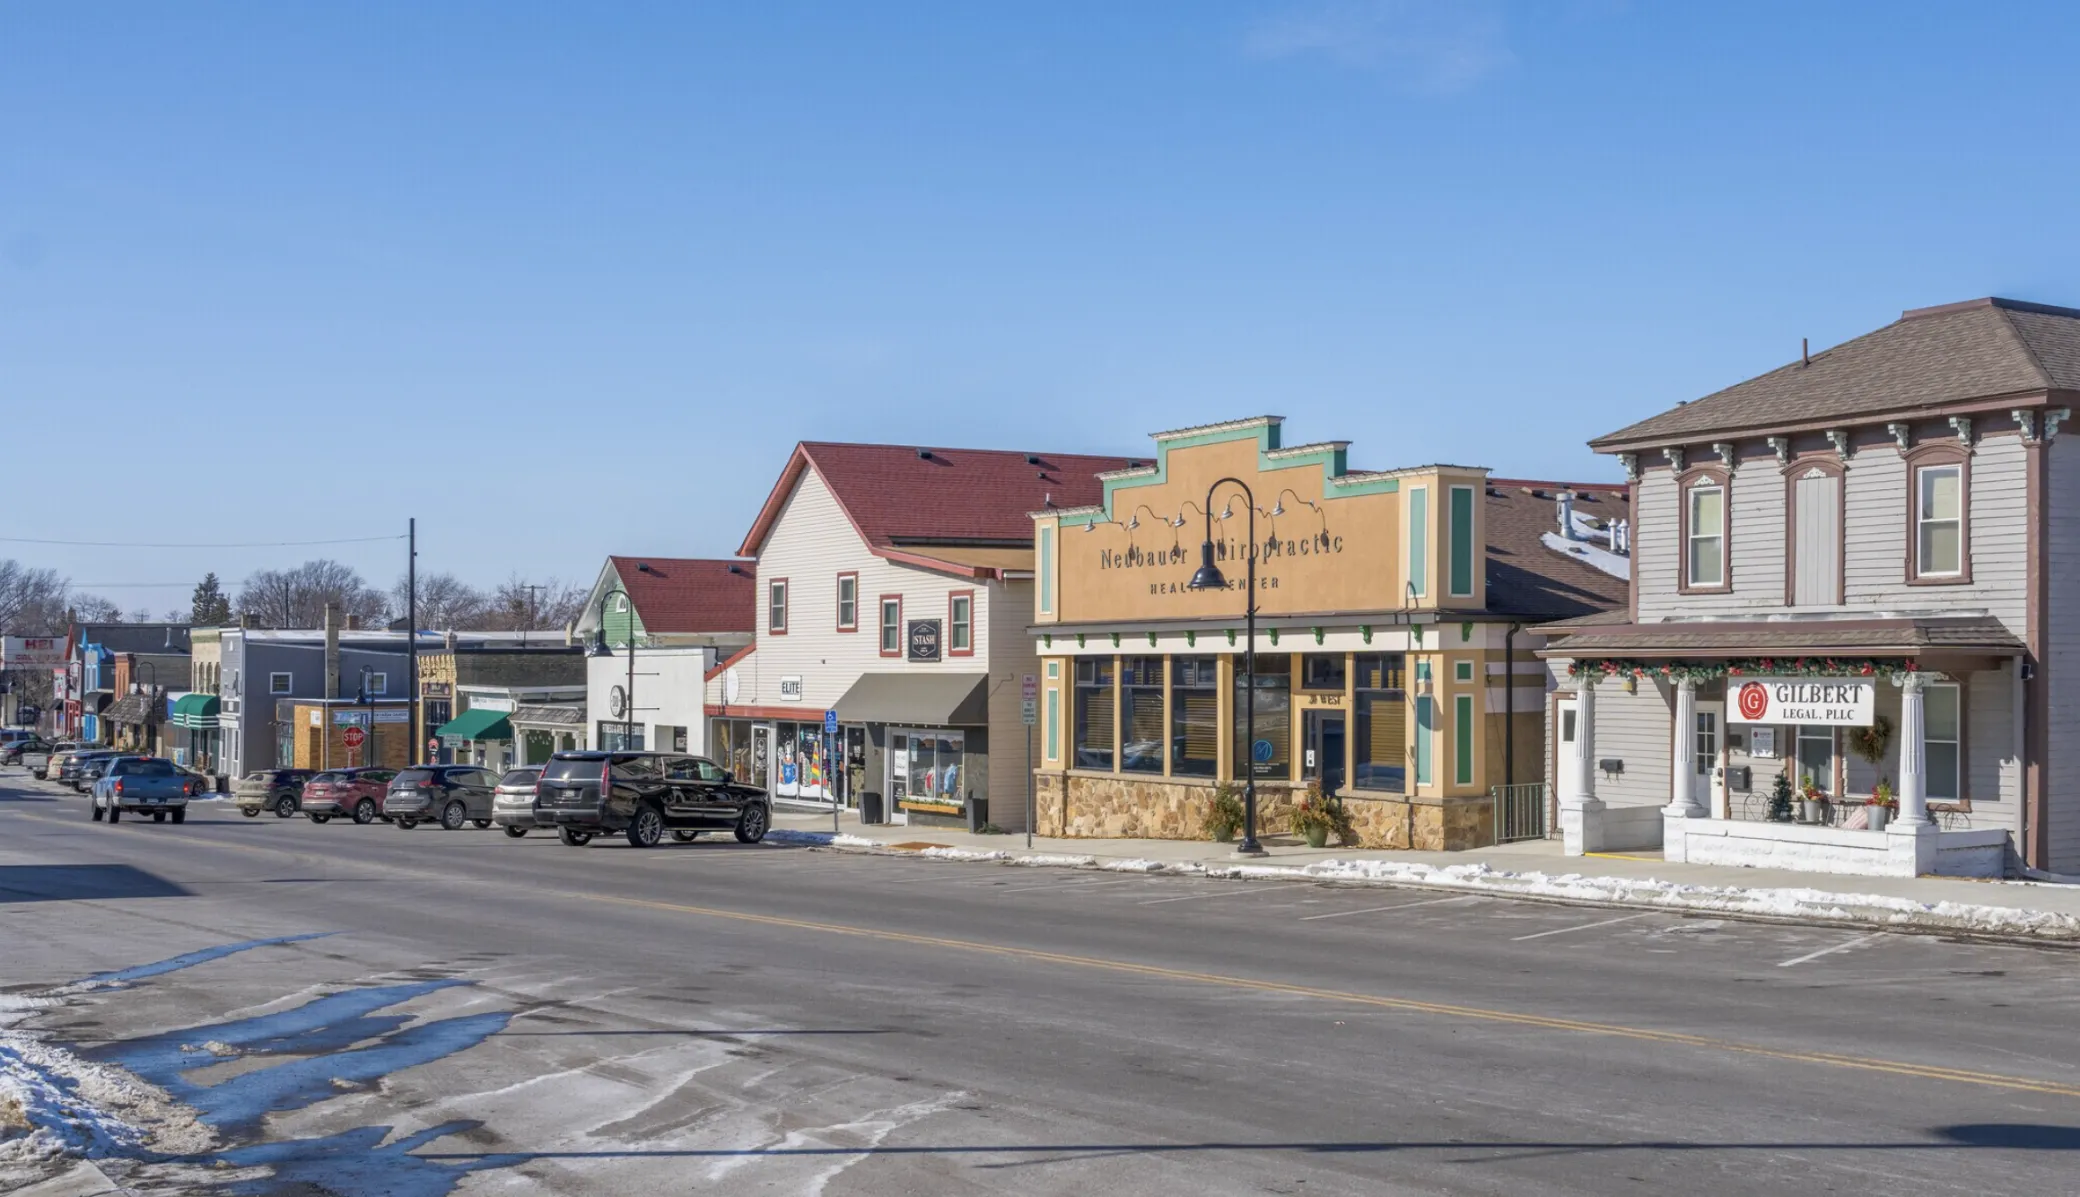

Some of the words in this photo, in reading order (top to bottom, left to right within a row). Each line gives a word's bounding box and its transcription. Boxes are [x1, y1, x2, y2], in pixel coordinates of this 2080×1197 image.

[1100, 546, 1188, 570] Neubauer
[1215, 528, 1344, 565] hiropractic
[1150, 582, 1206, 596] HEAL
[1220, 576, 1280, 592] ENER
[912, 635, 935, 646] STASH
[781, 680, 800, 695] ELITE
[1776, 685, 1863, 704] GILBERT
[1747, 692, 1760, 709] G
[1783, 708, 1822, 720] LEGAL,
[1825, 709, 1855, 720] PLLC
[343, 733, 363, 742] STOP
